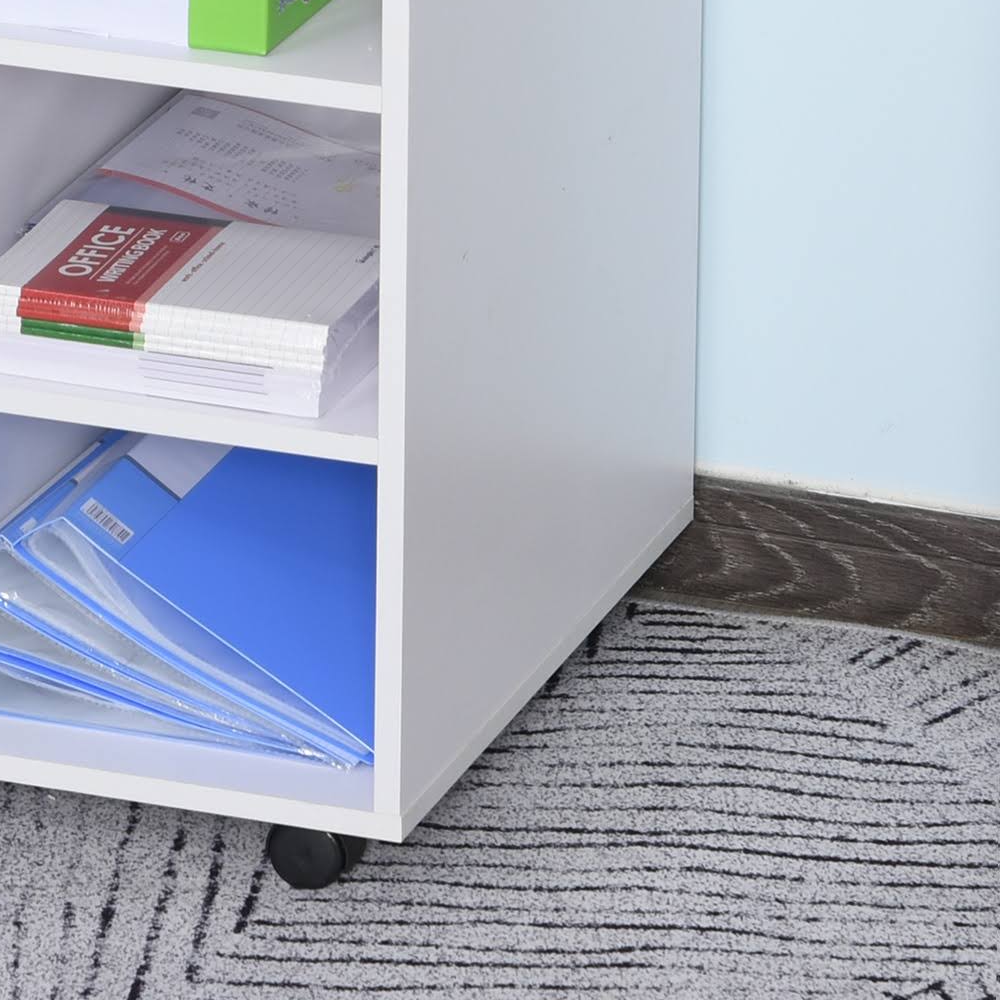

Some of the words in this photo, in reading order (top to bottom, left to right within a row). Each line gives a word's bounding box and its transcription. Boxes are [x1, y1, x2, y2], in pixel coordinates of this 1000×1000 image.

[58, 224, 136, 277] OFFICE
[96, 249, 145, 283] WRITING
[130, 227, 168, 252] BOOK
